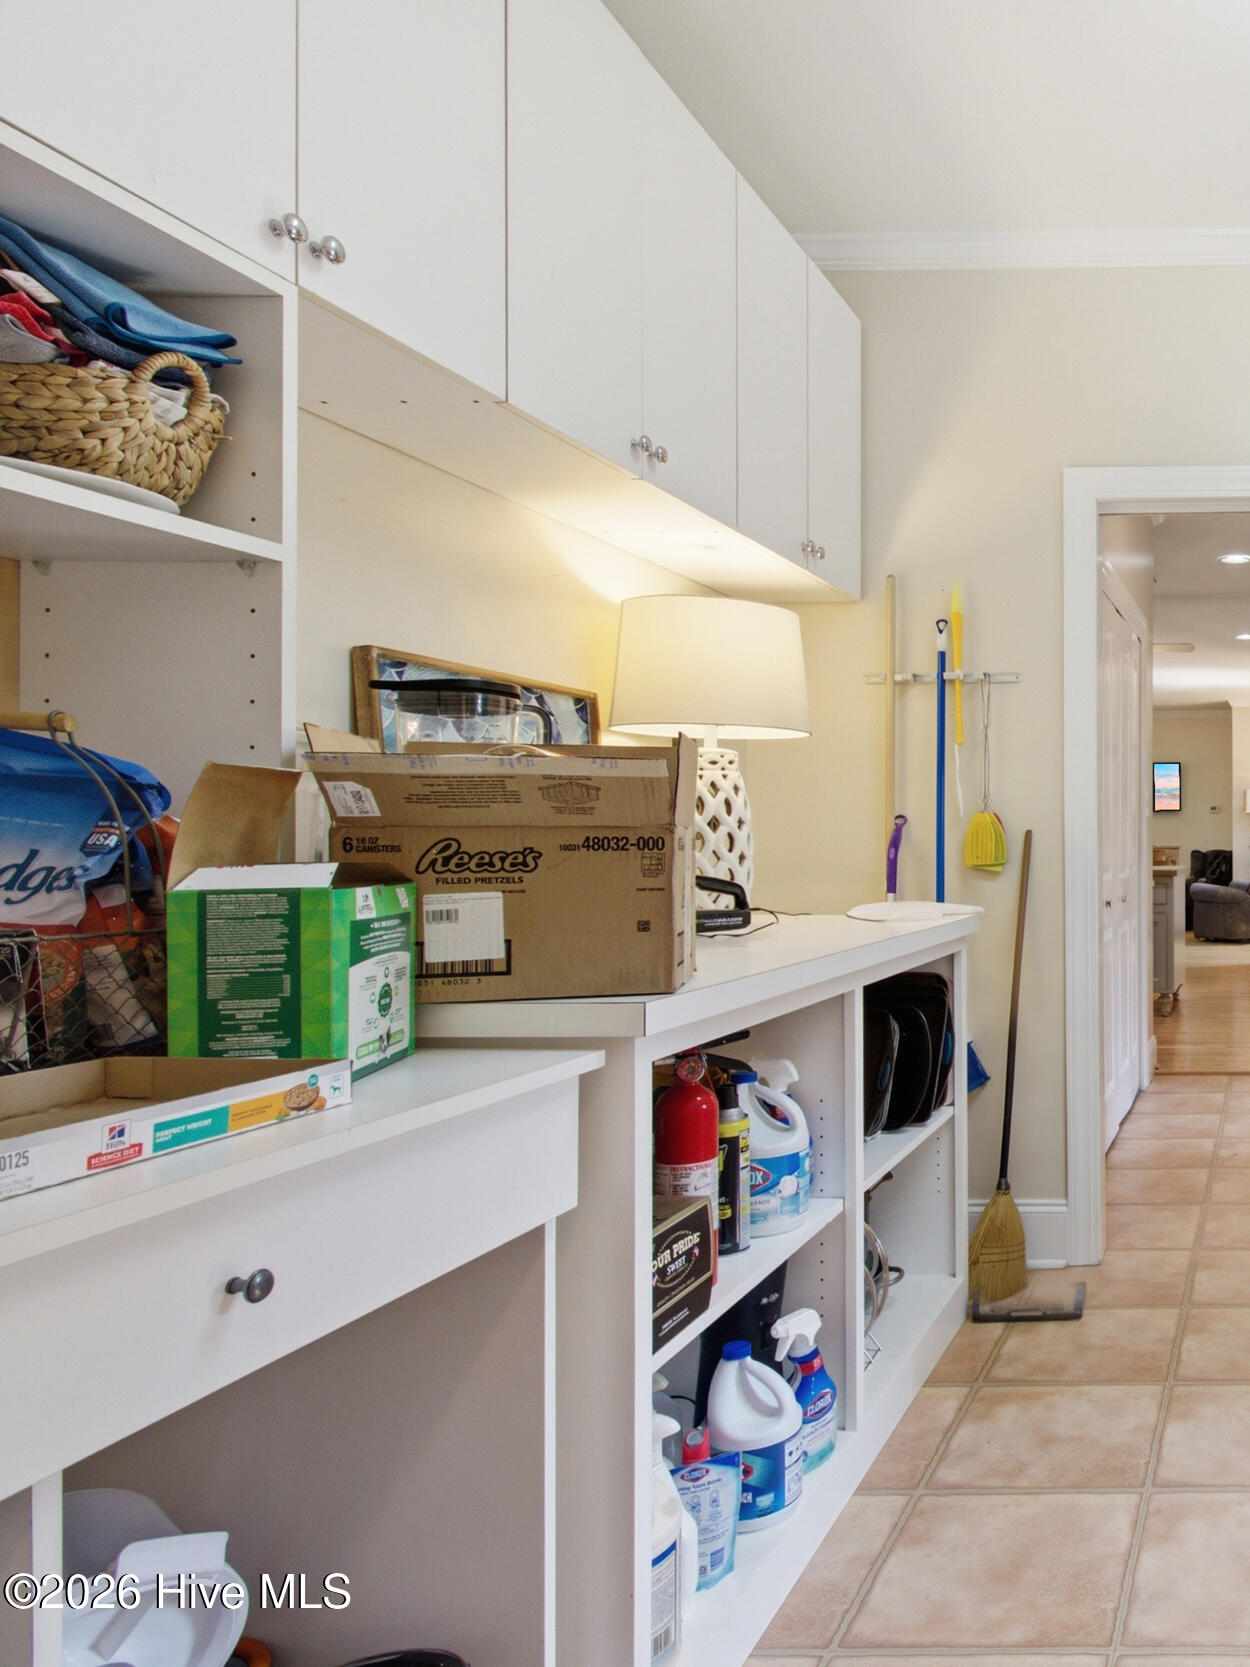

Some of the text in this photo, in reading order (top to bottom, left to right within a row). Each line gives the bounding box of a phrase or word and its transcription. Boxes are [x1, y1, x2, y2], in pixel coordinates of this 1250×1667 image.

[87, 833, 118, 847] USA
[343, 837, 354, 853] 6
[582, 836, 665, 852] 48032-000
[356, 845, 402, 853] CANISTERS
[415, 838, 543, 874] Reese's
[436, 876, 524, 885] FILLED PRETZELS
[91, 1152, 121, 1164] SCIENCE
[673, 1232, 702, 1258] PRIDE
[667, 1255, 686, 1276] SWEET
[807, 1393, 832, 1417] CLOROX
[683, 1468, 706, 1480] CLOROX
